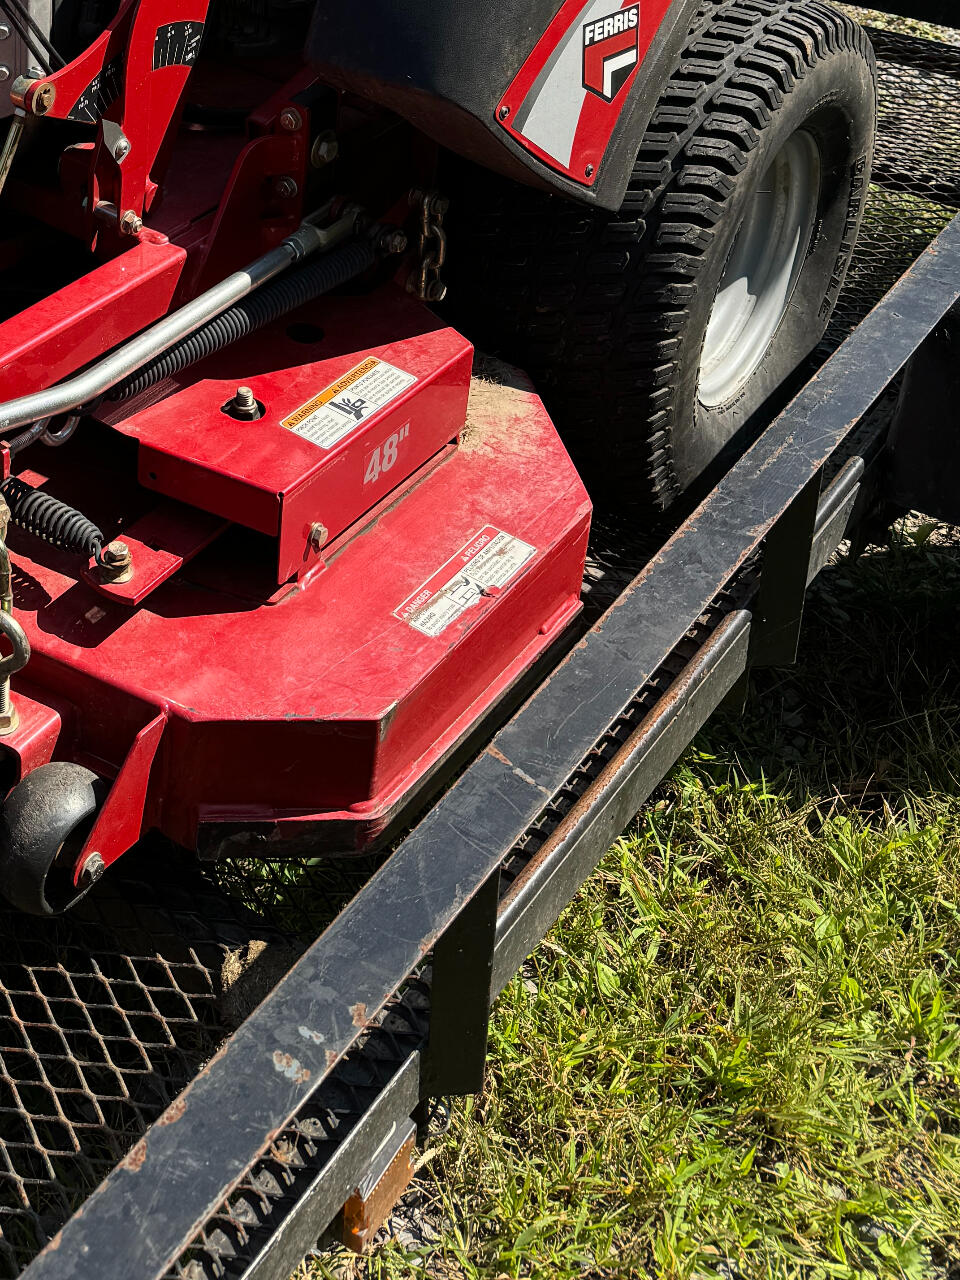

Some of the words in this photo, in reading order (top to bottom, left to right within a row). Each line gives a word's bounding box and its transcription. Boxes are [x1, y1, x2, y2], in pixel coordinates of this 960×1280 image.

[584, 8, 638, 46] FERRIS
[292, 399, 323, 424] WARNING
[337, 359, 379, 390] ADVERTENCIA
[363, 423, 410, 485] 48"
[405, 589, 433, 616] DANGER
[466, 534, 491, 558] PELIGRO
